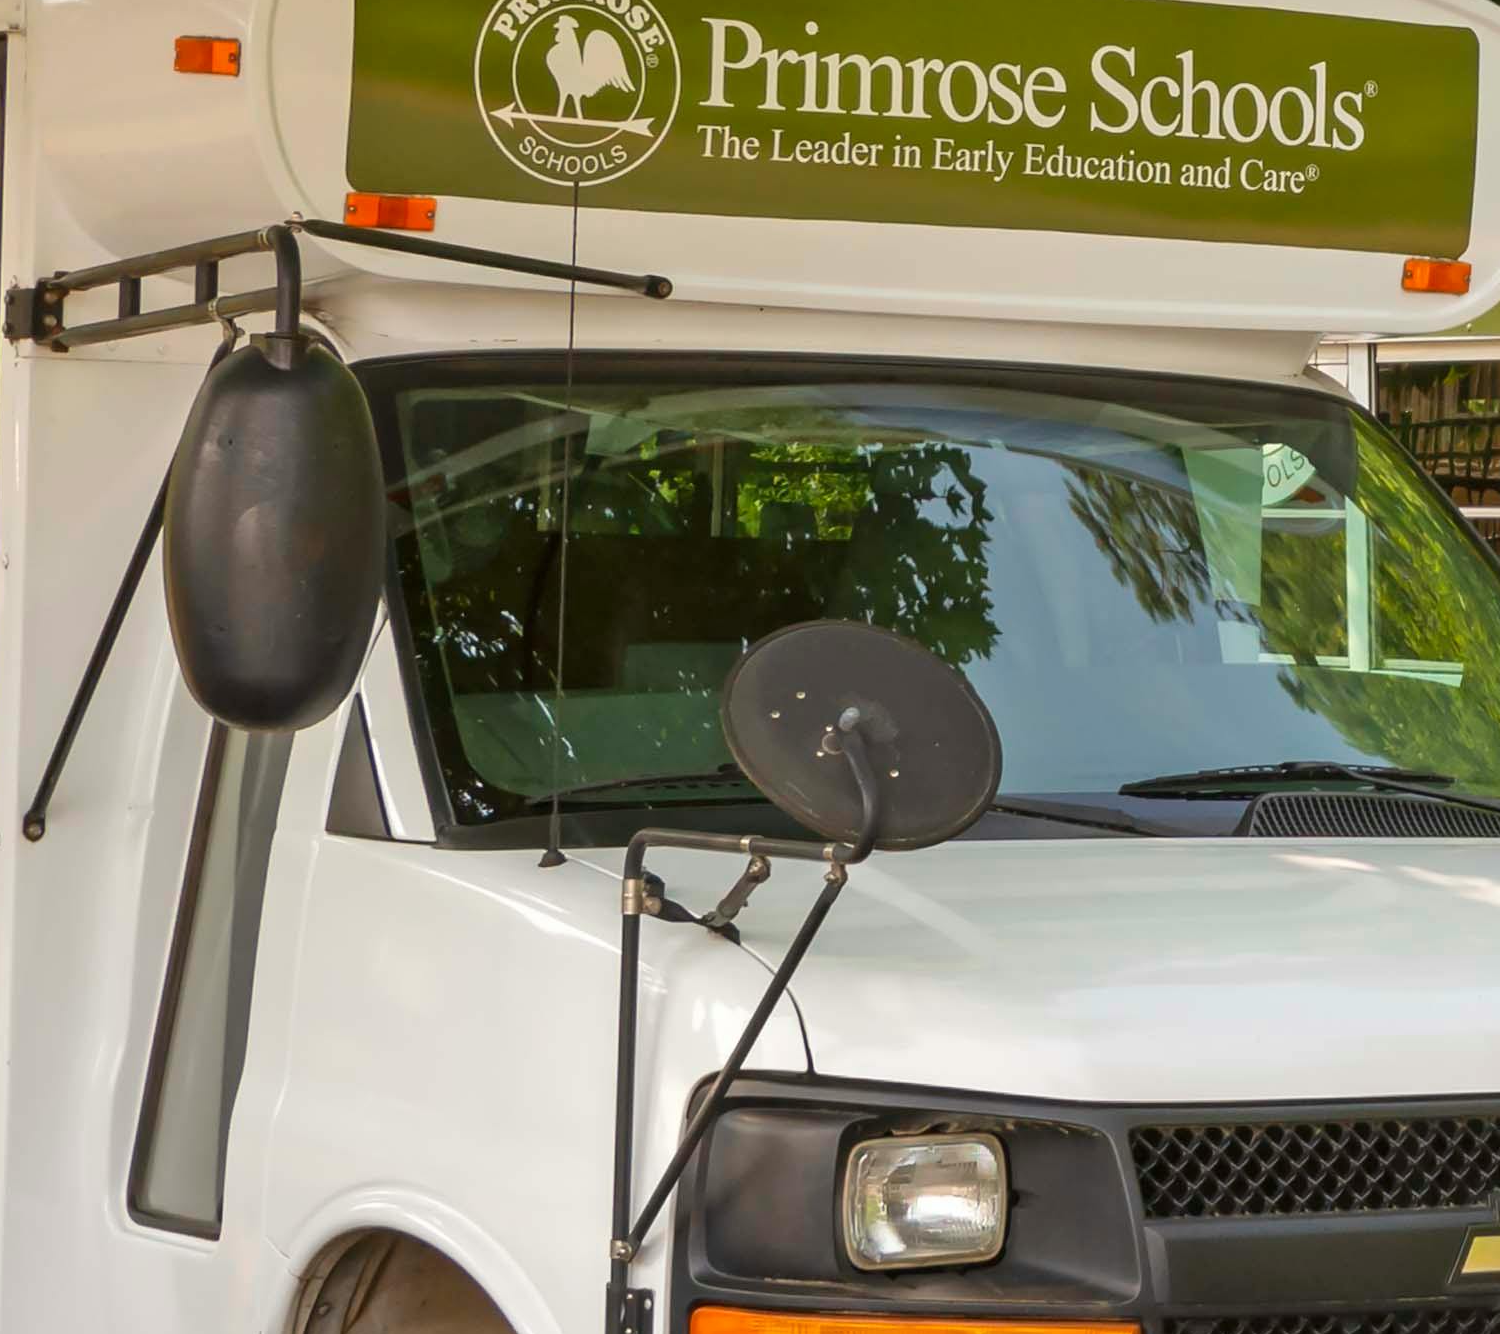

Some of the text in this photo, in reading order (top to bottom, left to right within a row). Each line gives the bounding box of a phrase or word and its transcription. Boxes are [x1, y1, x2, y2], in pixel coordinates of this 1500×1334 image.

[698, 17, 1067, 129] Primrose
[519, 136, 628, 175] SCHOOLS
[697, 124, 761, 161] The
[770, 129, 883, 167] Leader
[893, 134, 922, 169] in
[932, 137, 1014, 183] Early
[1022, 143, 1172, 185] Education
[1180, 157, 1231, 190] and
